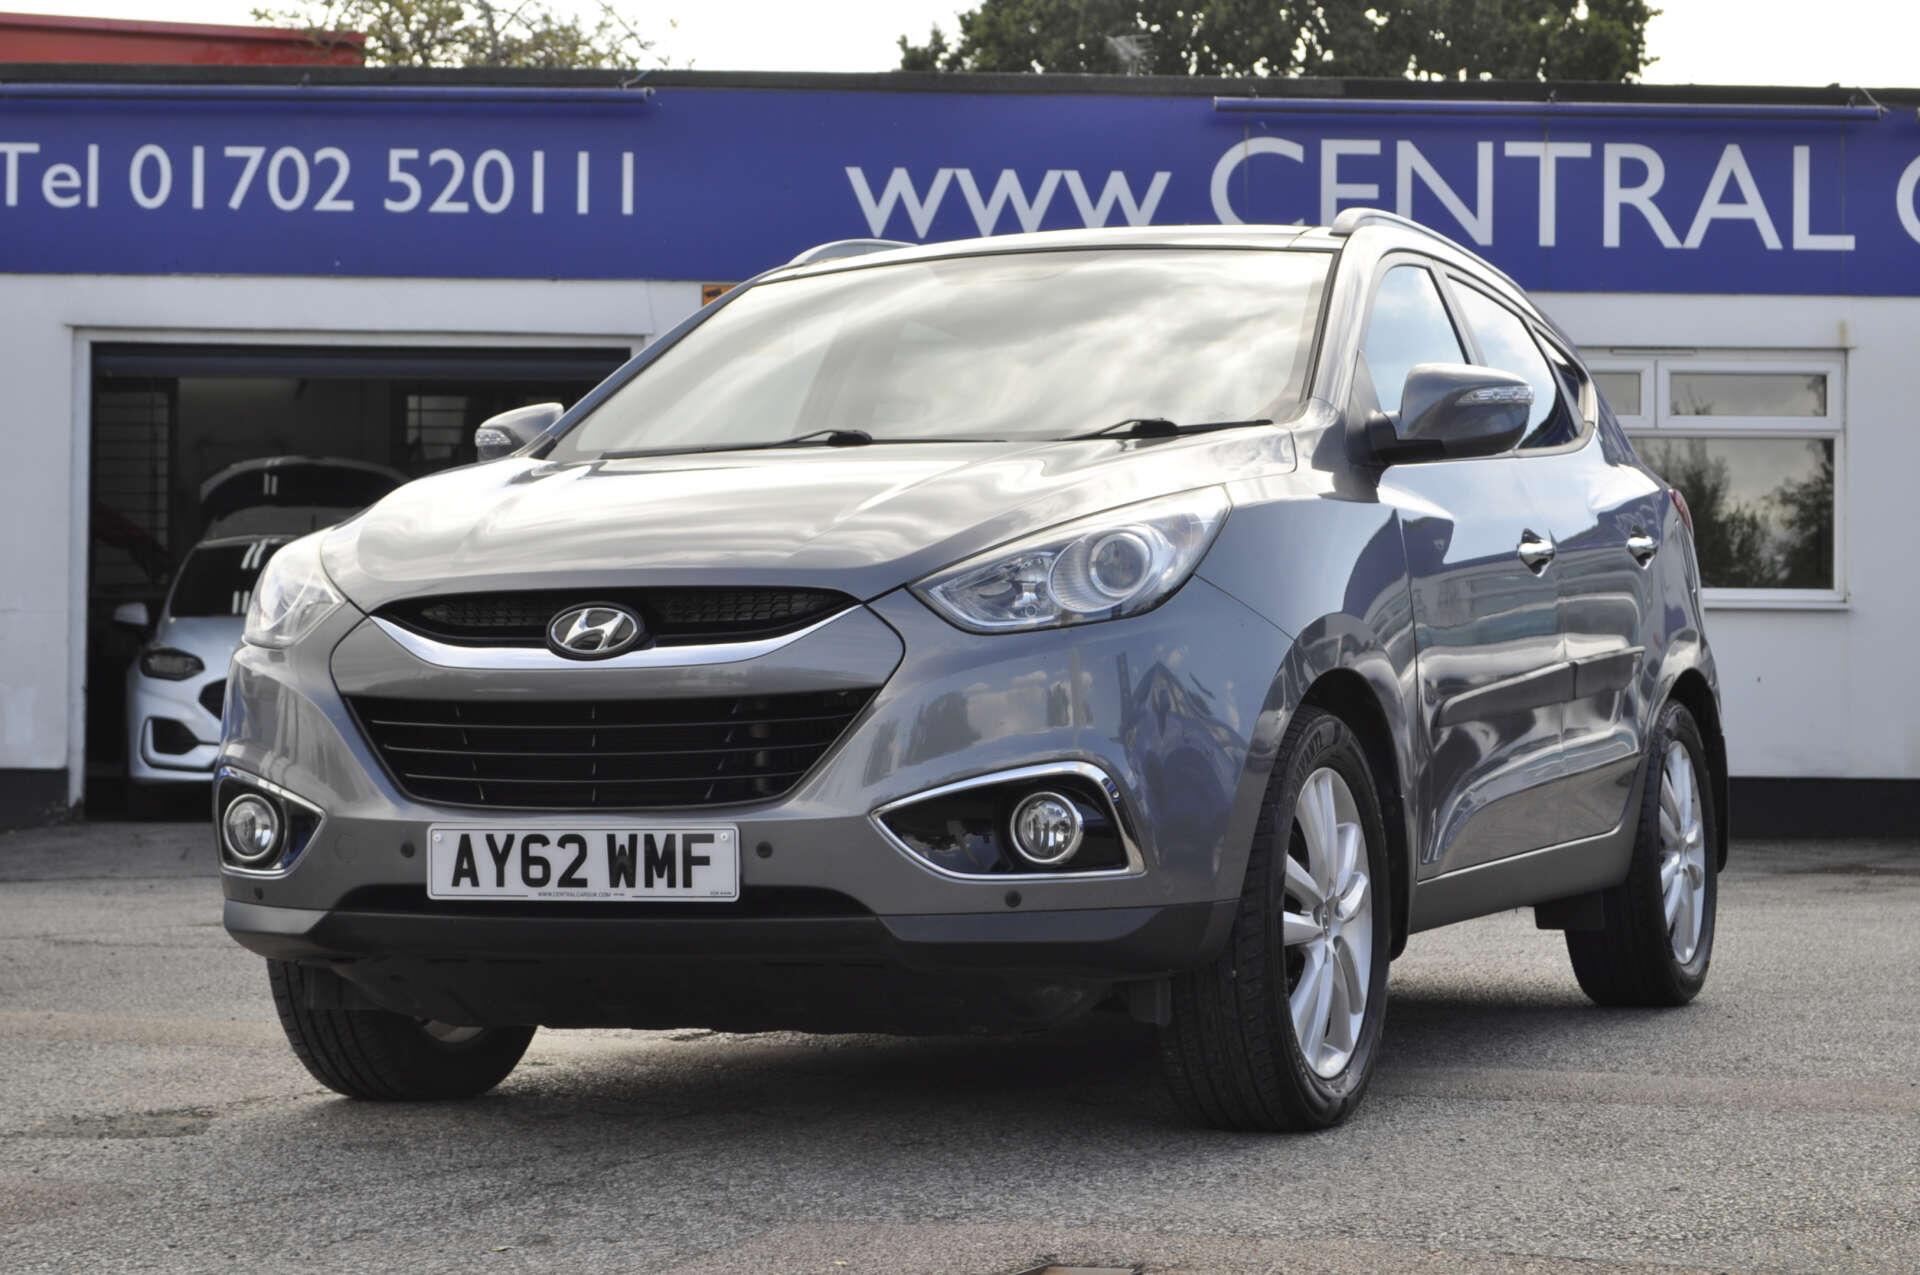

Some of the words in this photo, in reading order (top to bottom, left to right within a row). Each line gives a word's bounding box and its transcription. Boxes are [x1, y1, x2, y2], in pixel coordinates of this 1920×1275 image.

[0, 143, 98, 208] Tel
[130, 145, 353, 211] 01702
[385, 149, 633, 214] 520111
[1210, 137, 1856, 250] CENTRAL
[452, 834, 588, 888] AY62
[607, 833, 715, 889] WMF
